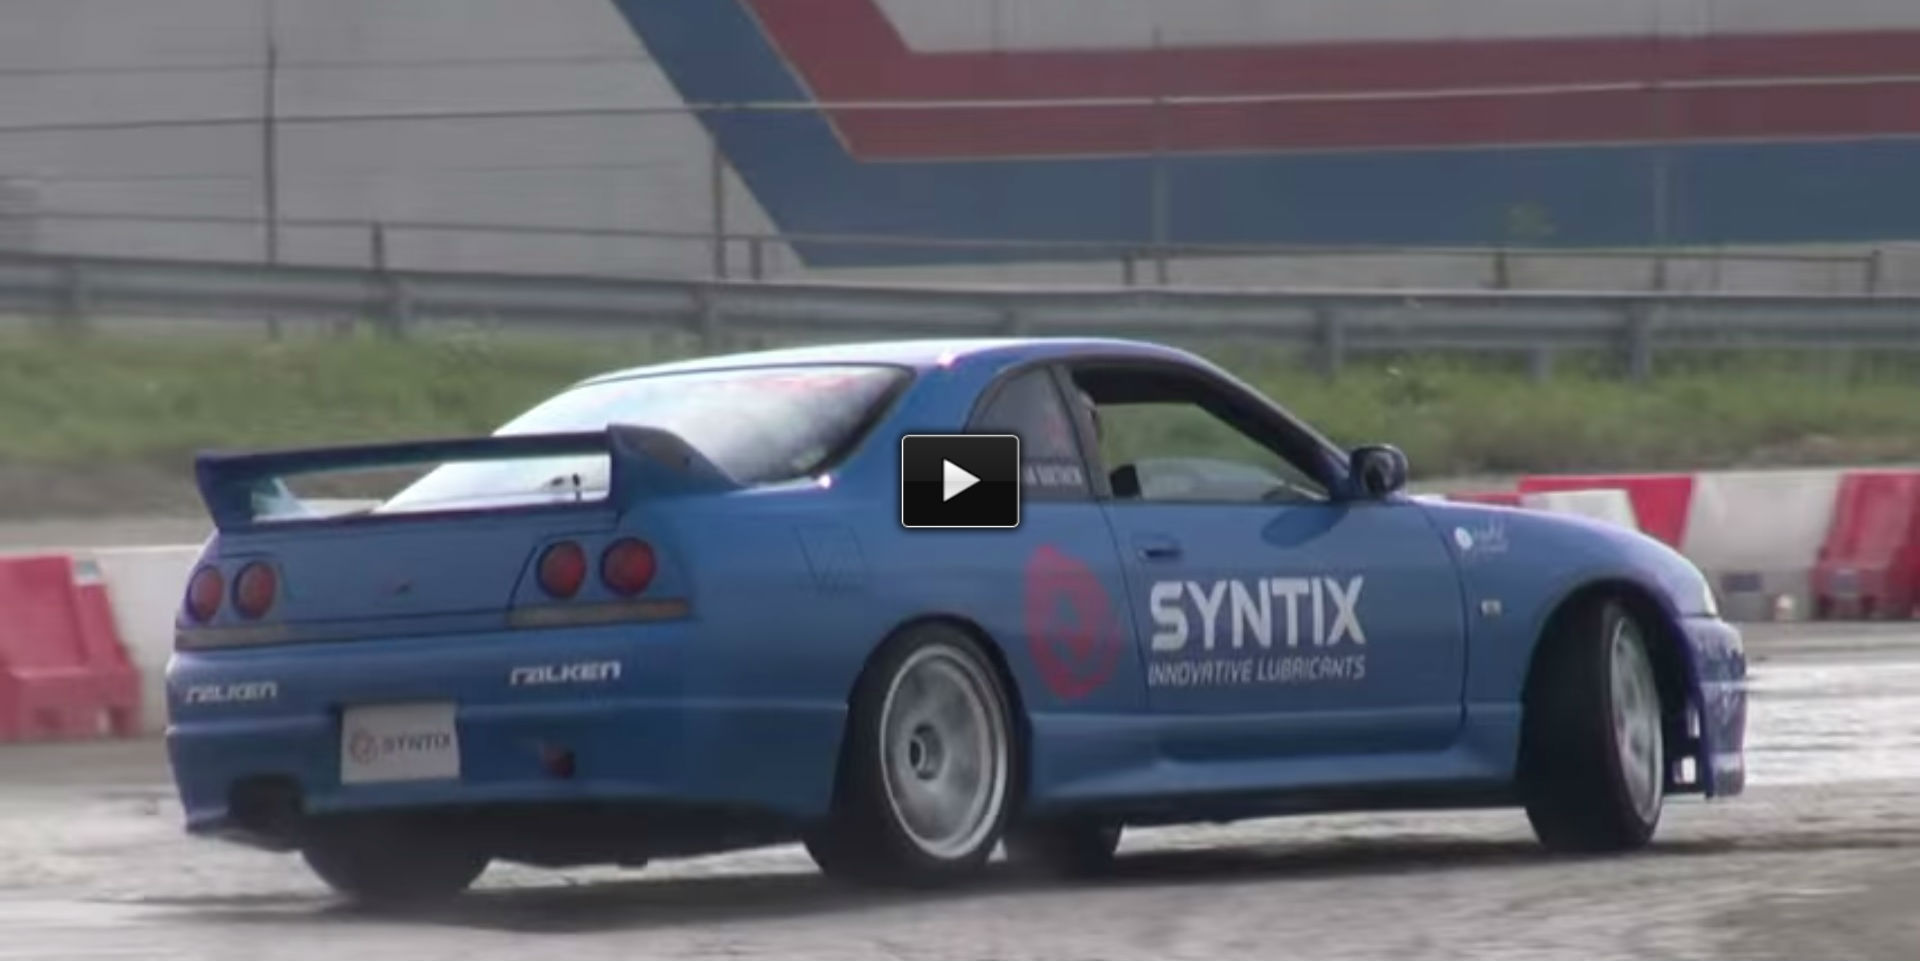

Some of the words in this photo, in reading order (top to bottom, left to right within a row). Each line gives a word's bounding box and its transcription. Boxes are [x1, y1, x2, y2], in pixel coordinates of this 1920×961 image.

[1150, 575, 1366, 652] SYNTIX
[1149, 658, 1252, 686] INNOVATIVE
[1257, 653, 1366, 681] LUBRICANTS
